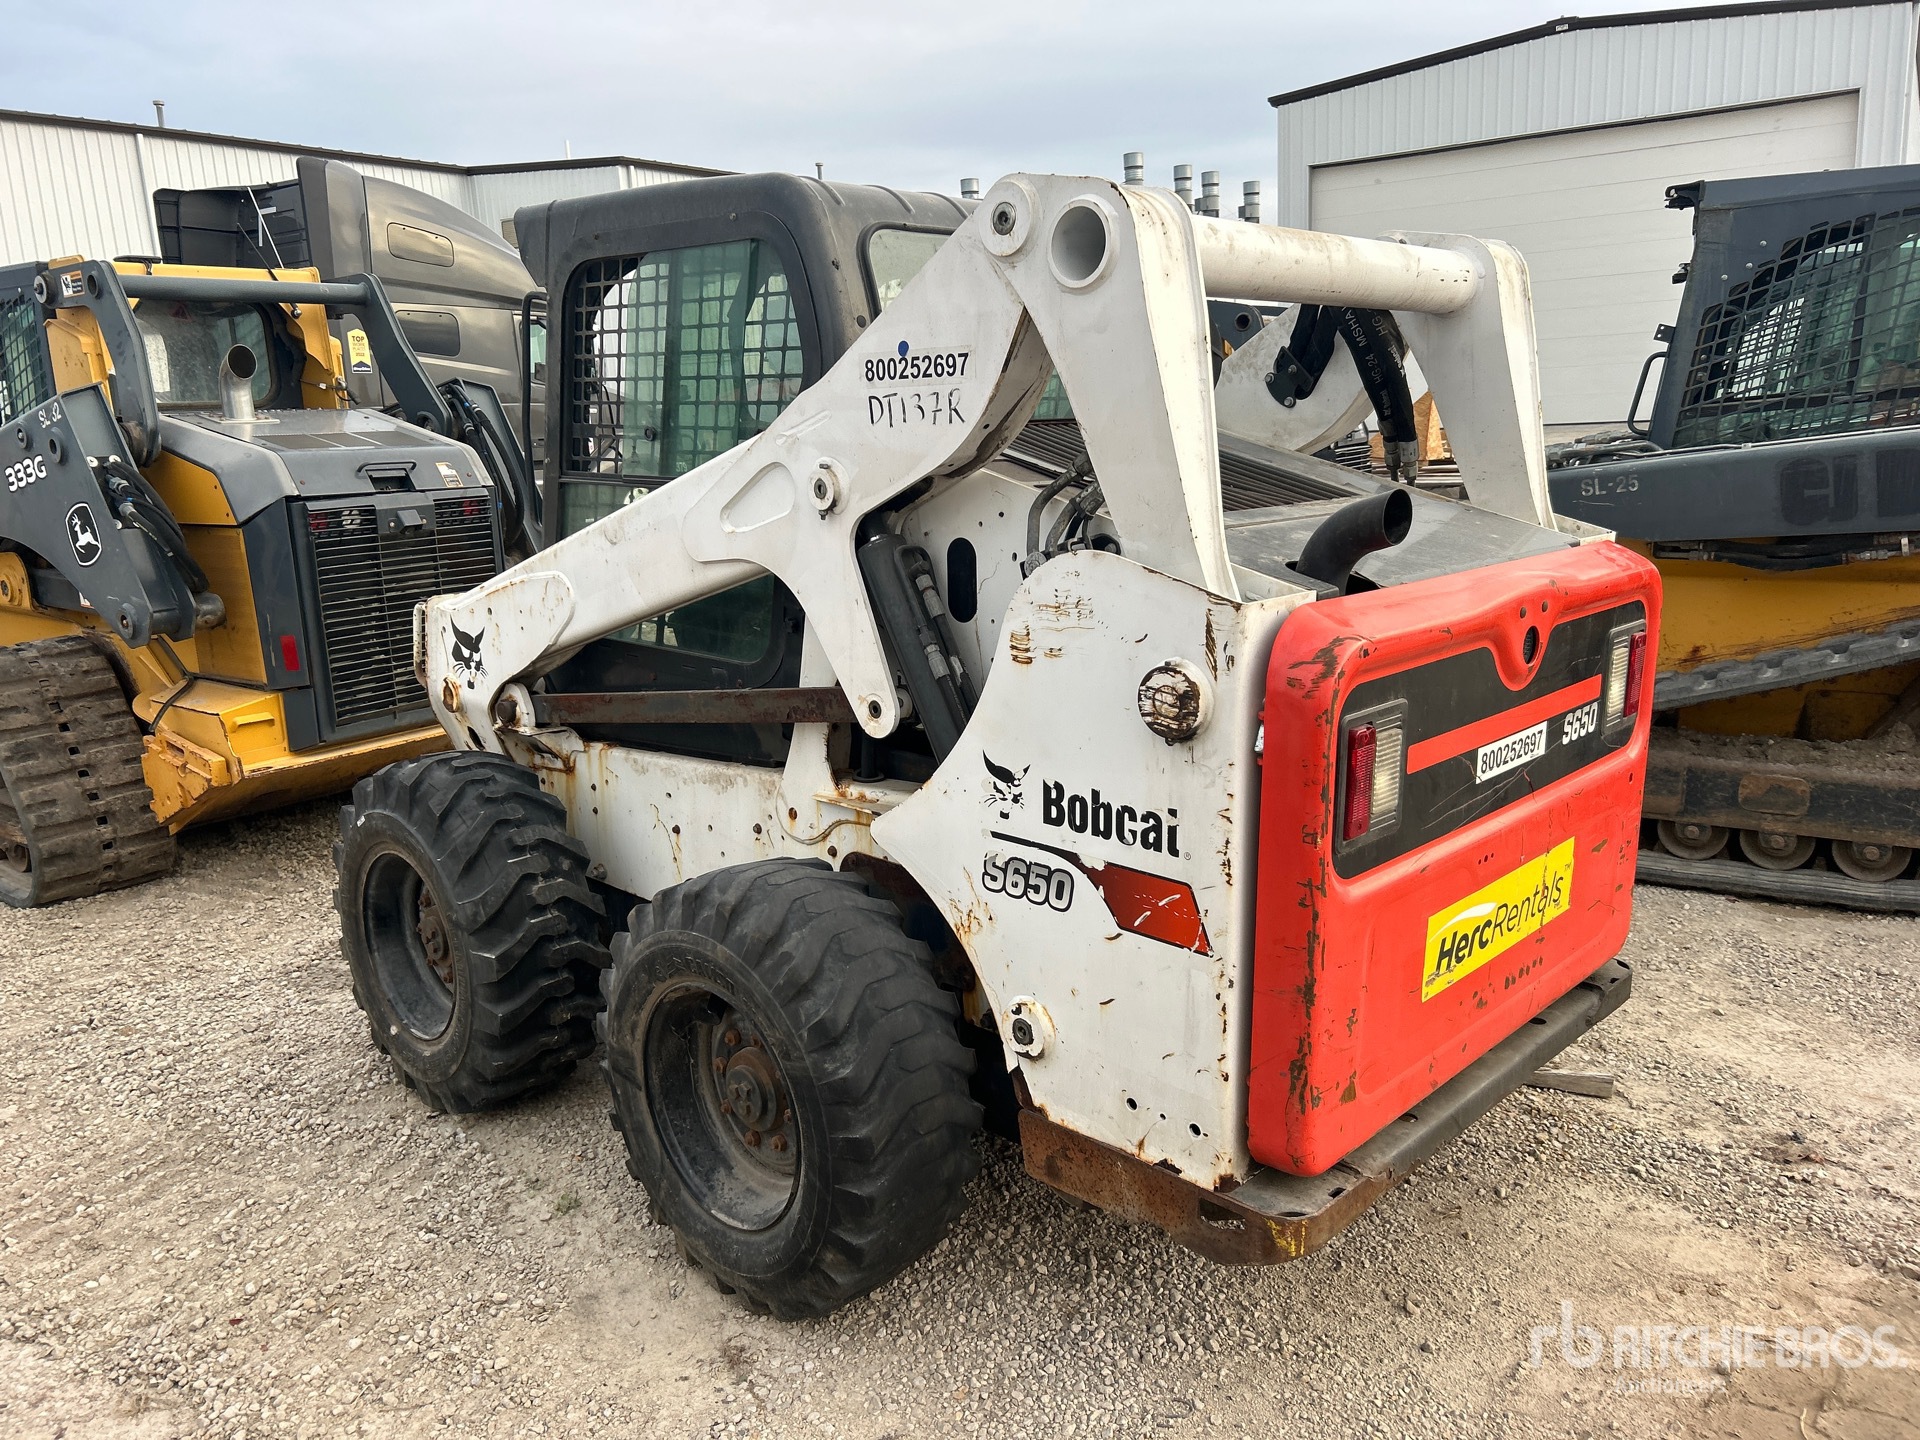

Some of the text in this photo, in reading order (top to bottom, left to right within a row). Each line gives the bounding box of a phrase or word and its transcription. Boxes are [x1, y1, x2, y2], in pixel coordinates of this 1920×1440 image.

[351, 335, 365, 343] TOP
[1344, 309, 1368, 347] MSHA
[865, 352, 969, 382] 800252697
[868, 388, 966, 428] DT137R
[4, 454, 48, 493] 333G
[1580, 474, 1639, 497] SL-25
[1562, 701, 1599, 746] S650
[1480, 729, 1544, 775] 800252697
[981, 852, 1075, 913] S650
